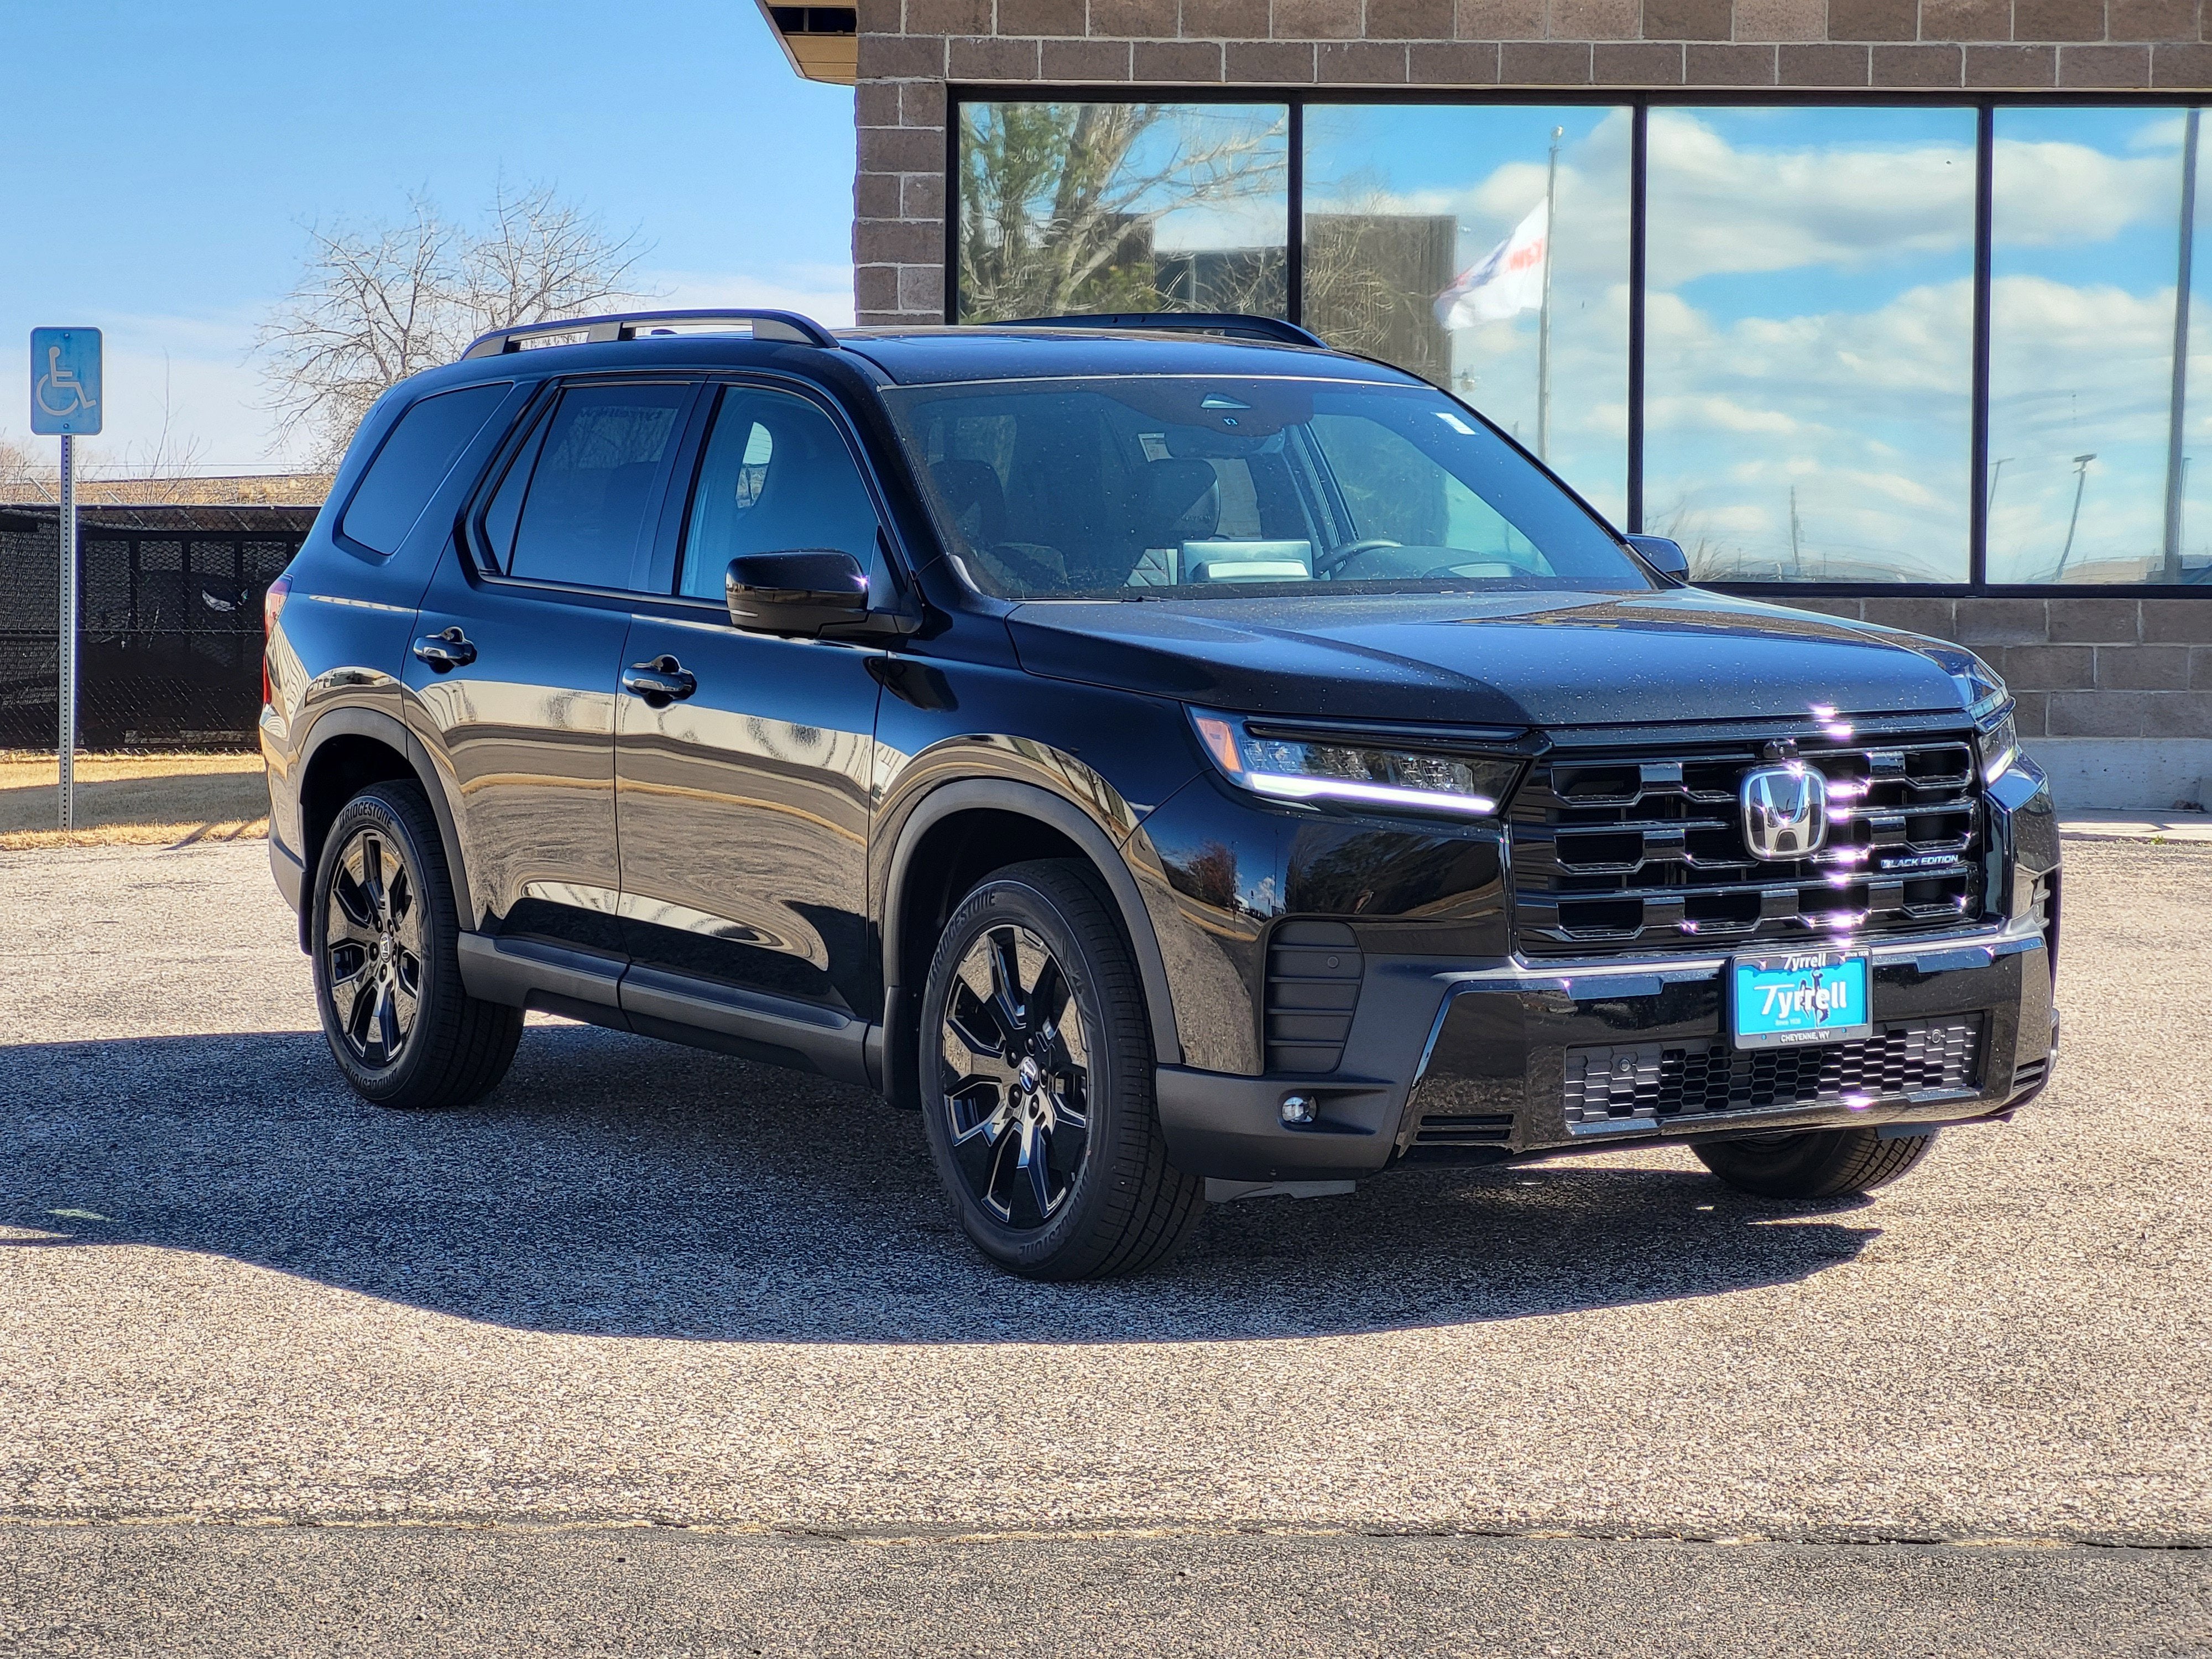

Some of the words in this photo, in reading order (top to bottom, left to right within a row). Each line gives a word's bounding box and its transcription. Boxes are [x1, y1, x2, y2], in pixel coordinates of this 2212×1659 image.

[339, 802, 394, 831] BRIDGESTONE
[1881, 858, 1919, 869] BLACK
[1921, 855, 1958, 865] EDITION
[930, 888, 996, 989] BRIDGESTONE
[1780, 953, 1827, 972] Tyrrell
[1754, 981, 1847, 1019] Tyrrell
[1781, 1031, 1818, 1042] CHEYENNE,
[1818, 1030, 1830, 1040] WY
